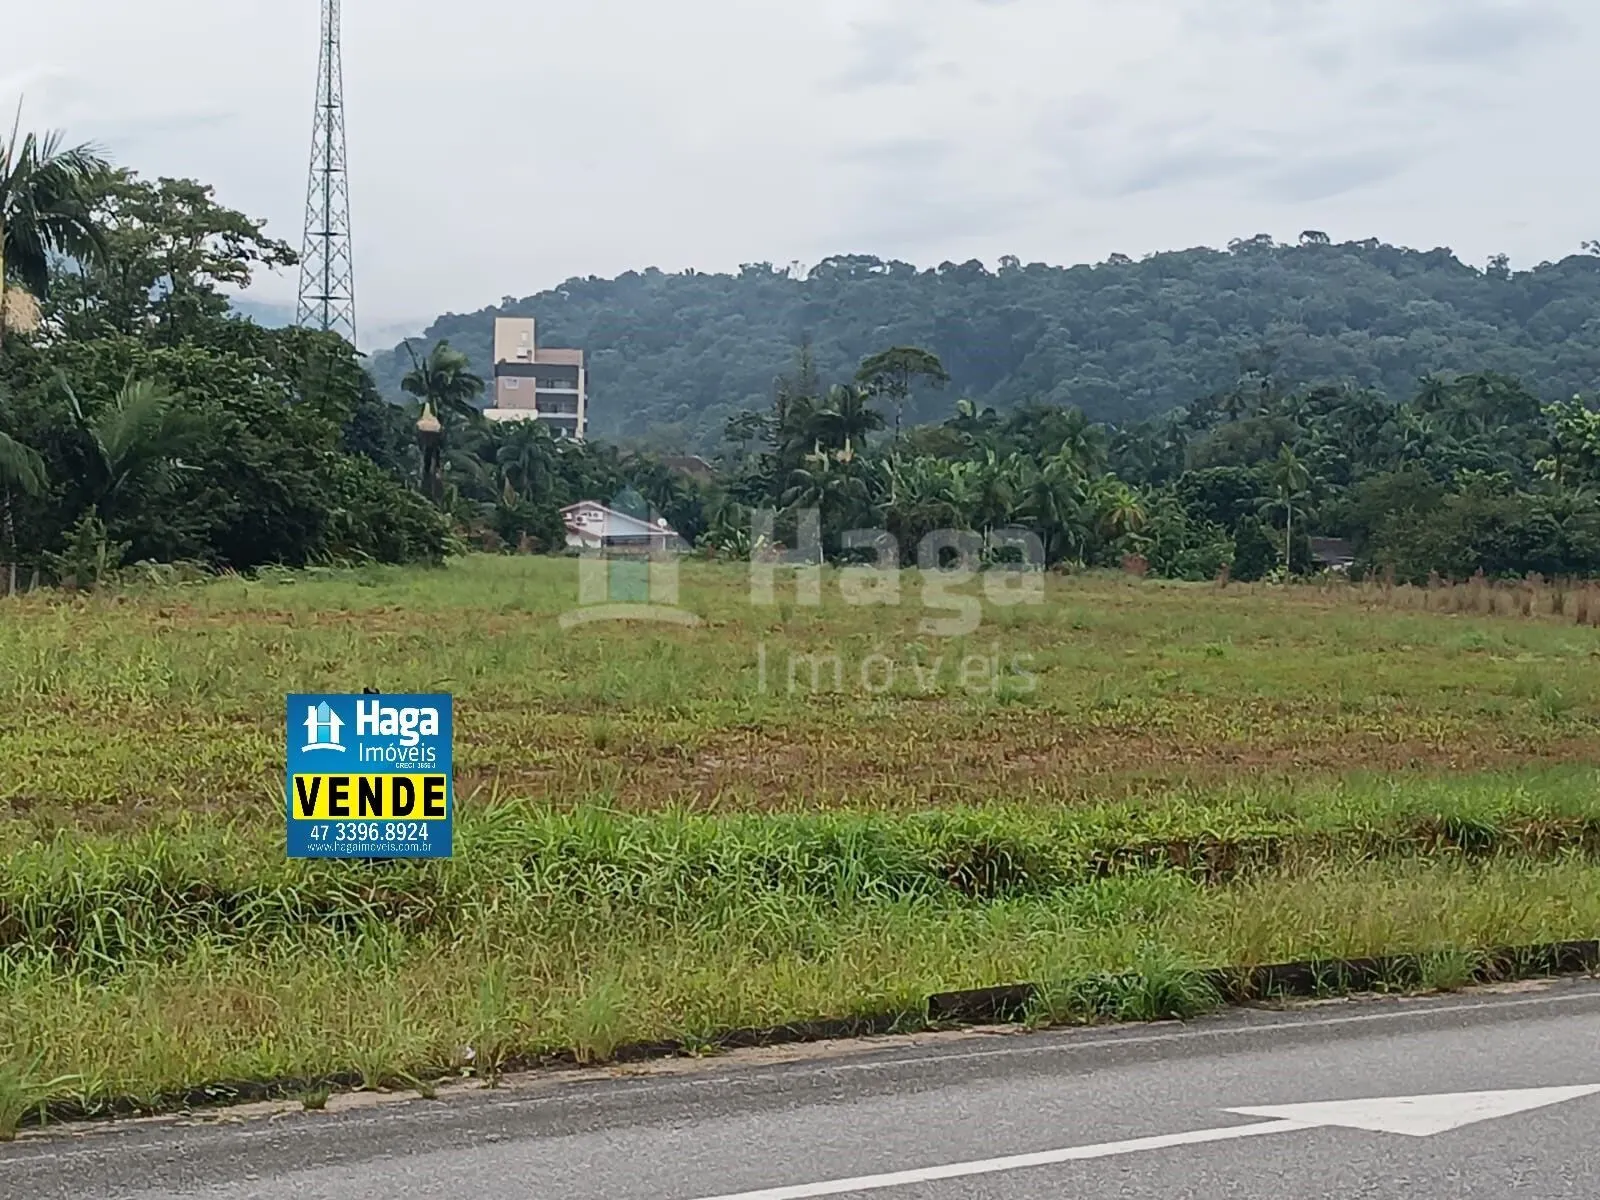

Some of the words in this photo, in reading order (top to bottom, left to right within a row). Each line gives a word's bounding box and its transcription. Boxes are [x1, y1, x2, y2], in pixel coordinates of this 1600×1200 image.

[356, 700, 439, 747] Haga
[359, 742, 436, 762] Imóveis
[294, 776, 445, 817] VENDE
[310, 825, 330, 841] 47
[335, 822, 429, 841] 3396.8924
[307, 841, 432, 854] www.hagaimoveis.com.br
